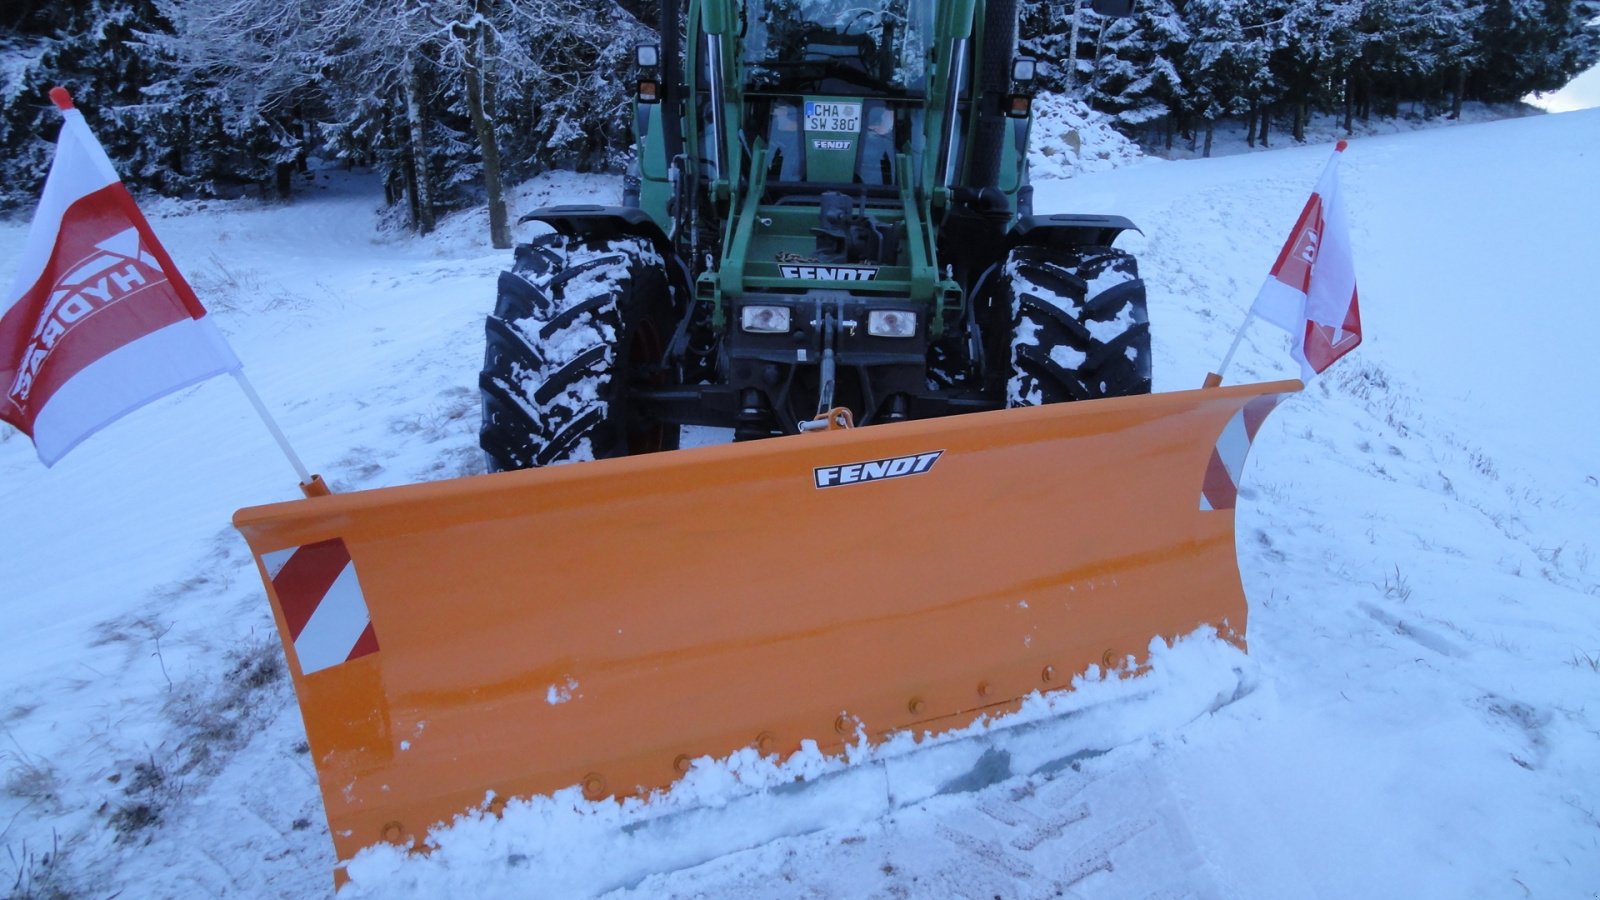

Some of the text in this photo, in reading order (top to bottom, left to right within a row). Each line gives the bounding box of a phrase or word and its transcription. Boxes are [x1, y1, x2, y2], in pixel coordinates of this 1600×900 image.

[814, 104, 839, 116] CHA
[811, 118, 827, 130] SW
[813, 140, 851, 149] FENDT
[781, 266, 875, 281] FENDT
[817, 452, 940, 486] FENDT
